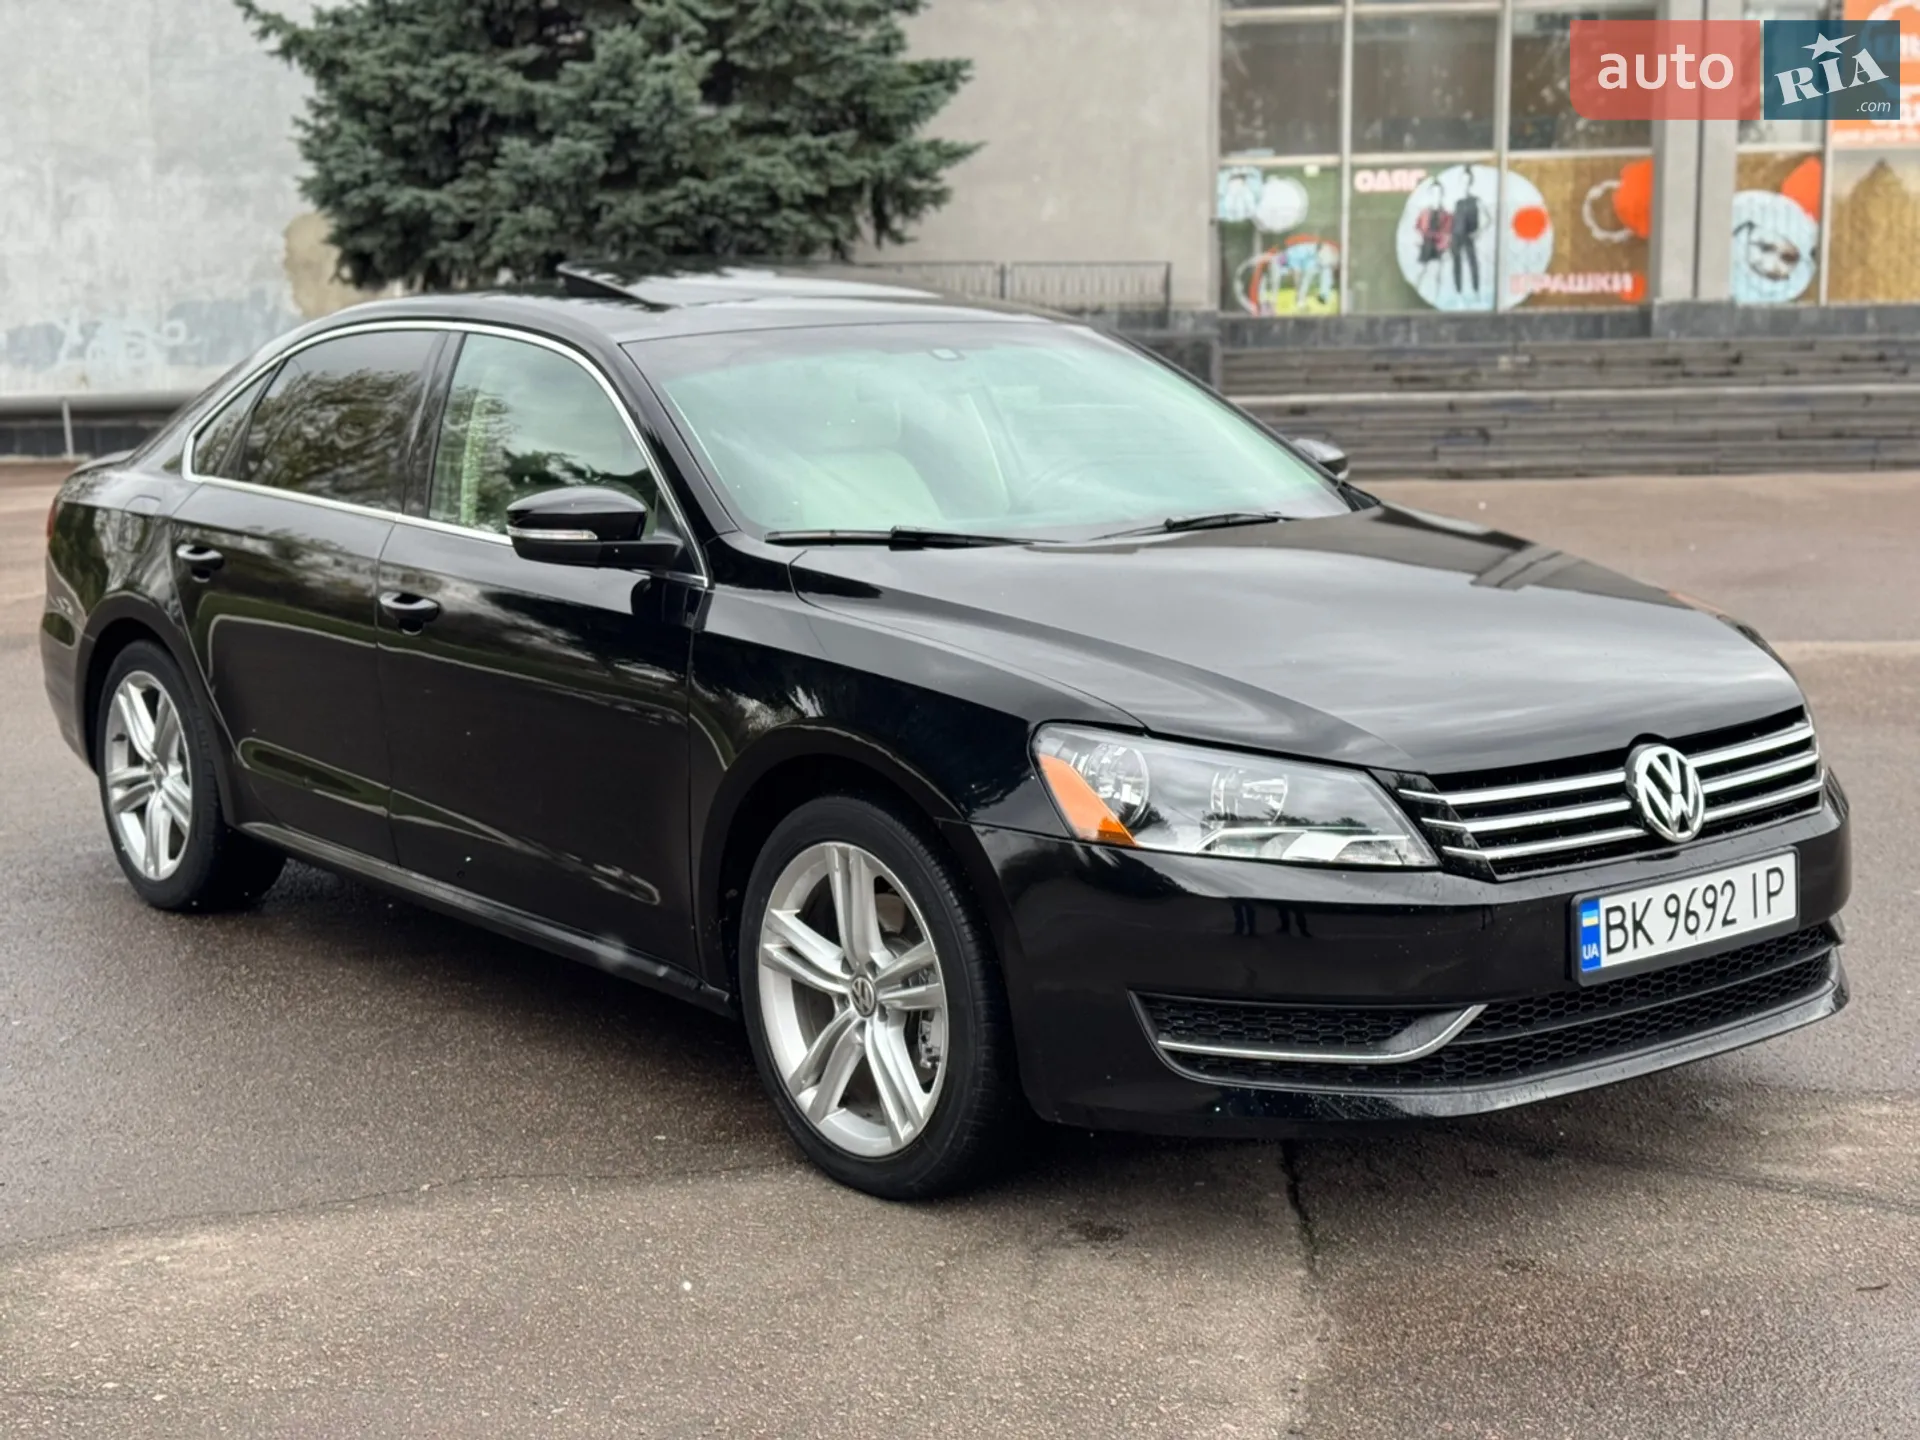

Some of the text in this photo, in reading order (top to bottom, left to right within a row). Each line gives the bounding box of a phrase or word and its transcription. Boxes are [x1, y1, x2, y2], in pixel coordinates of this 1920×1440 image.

[1604, 866, 1784, 957] BK 9692 IP
[1582, 943, 1600, 960] UA
